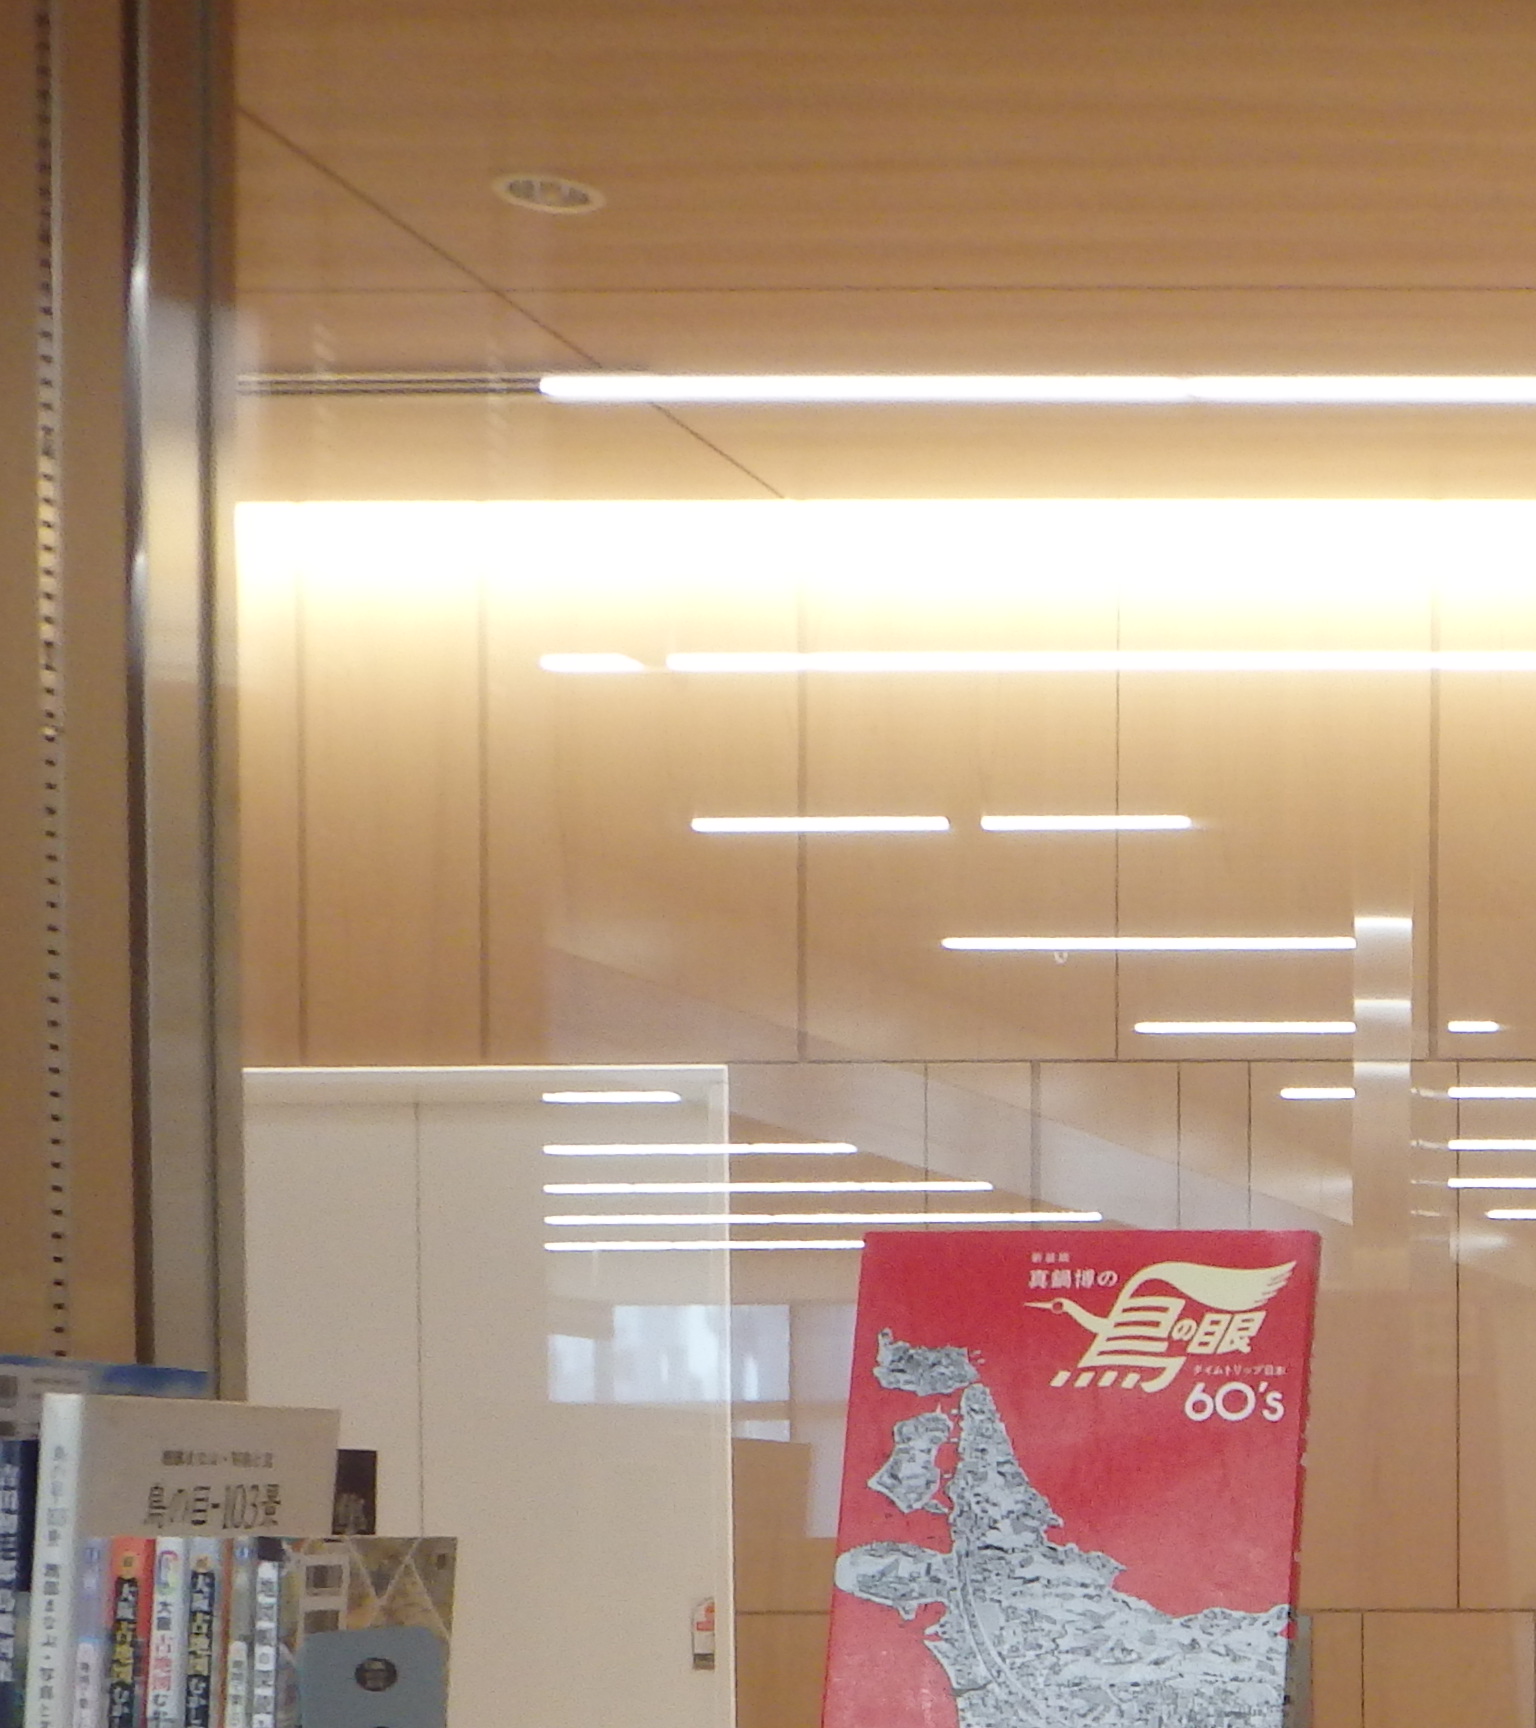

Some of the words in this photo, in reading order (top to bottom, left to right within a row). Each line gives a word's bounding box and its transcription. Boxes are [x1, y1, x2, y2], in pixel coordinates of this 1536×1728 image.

[1028, 1269, 1119, 1290] 真鍋博の
[1040, 1277, 1283, 1393] 鳥の眼
[1184, 1380, 1285, 1422] 60's
